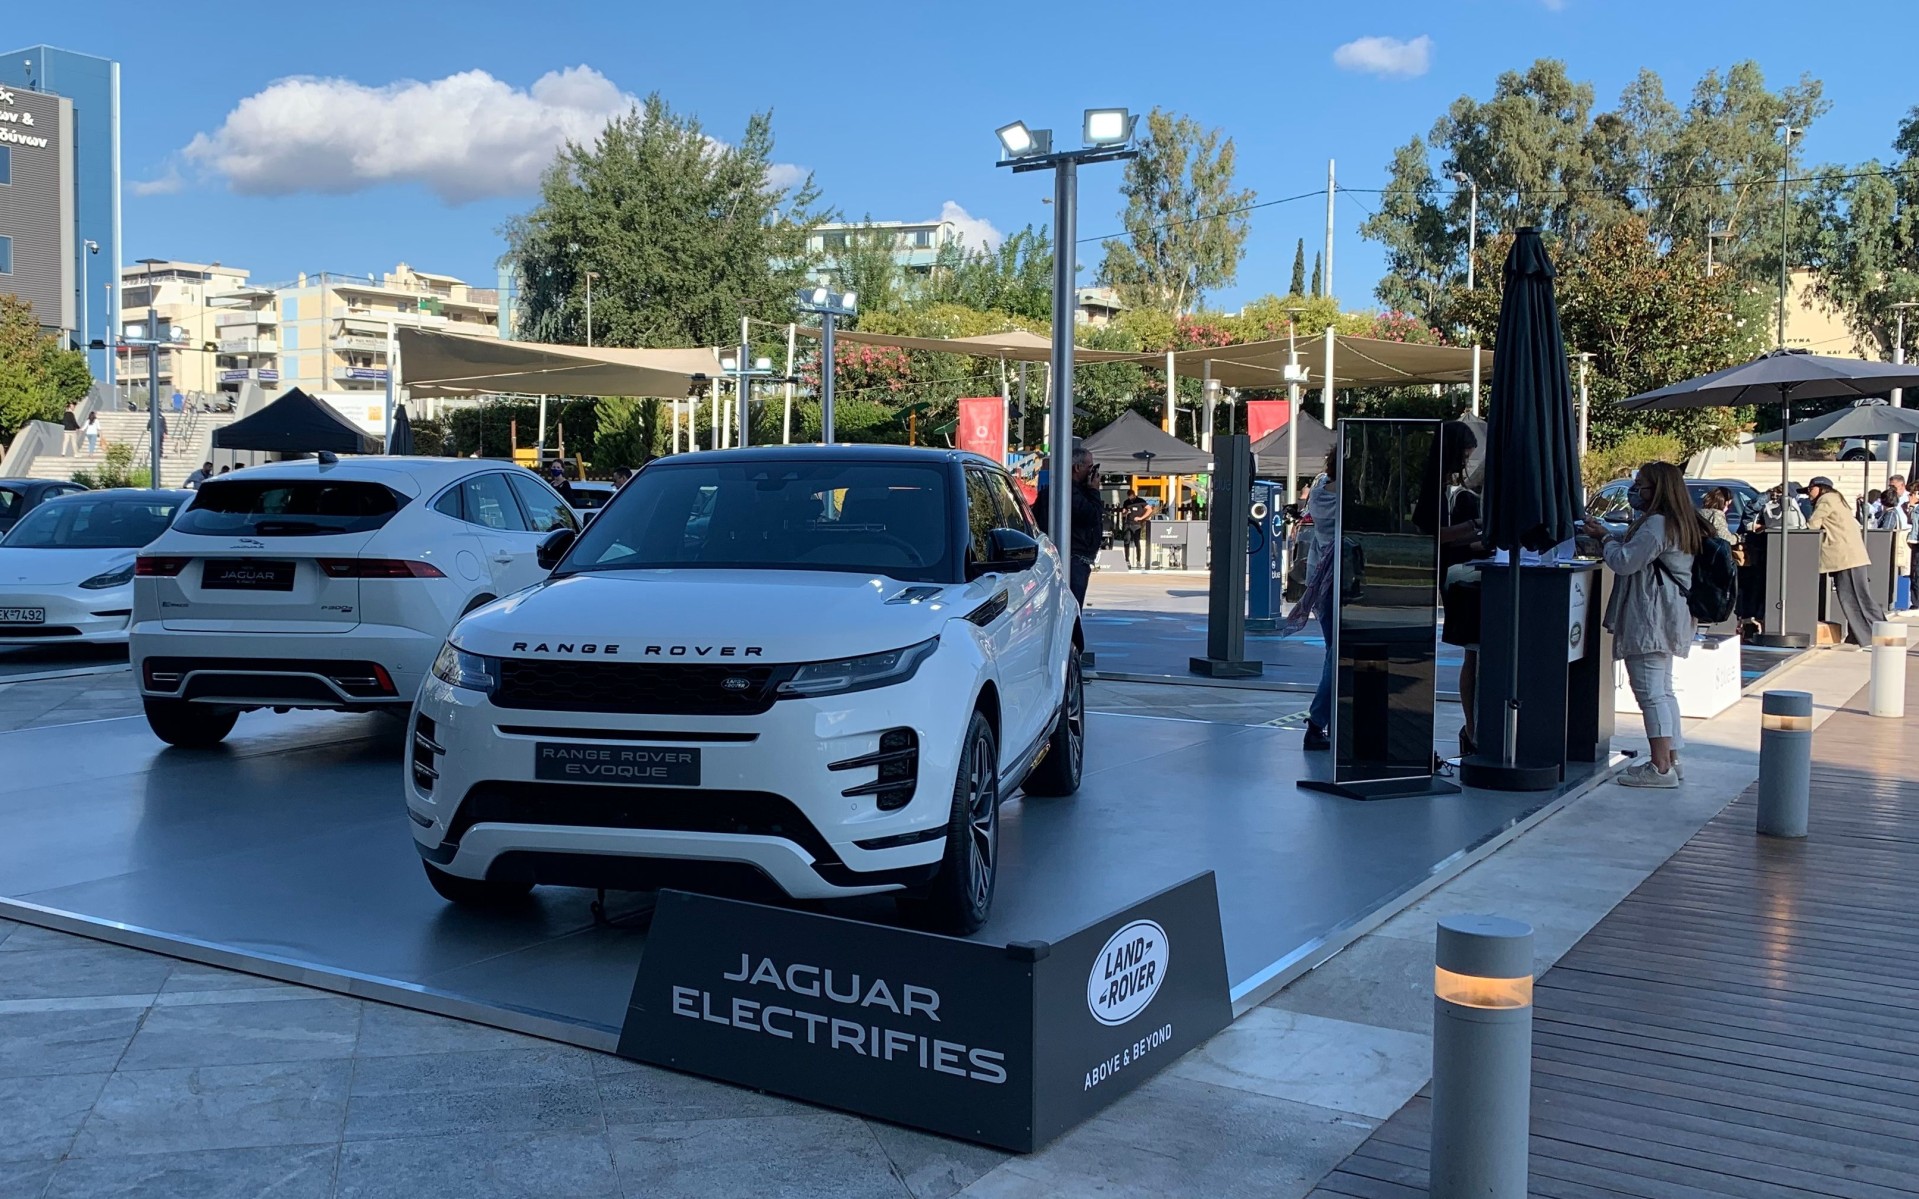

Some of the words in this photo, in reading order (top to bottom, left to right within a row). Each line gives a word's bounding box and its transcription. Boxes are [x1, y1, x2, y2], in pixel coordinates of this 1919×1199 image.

[22, 112, 34, 126] &
[220, 571, 275, 580] JAGUAR
[512, 642, 620, 654] RANGE
[645, 645, 763, 656] ROVER
[542, 748, 611, 761] RANGE
[620, 751, 692, 763] ROVER
[565, 764, 668, 777] EVOQUE
[723, 953, 942, 1022] JAGUAR
[672, 985, 1007, 1084] ELECTRIFIES
[1084, 1054, 1120, 1091] ABOVE
[1123, 1048, 1130, 1066] &
[1133, 1023, 1172, 1061] BEYOND
